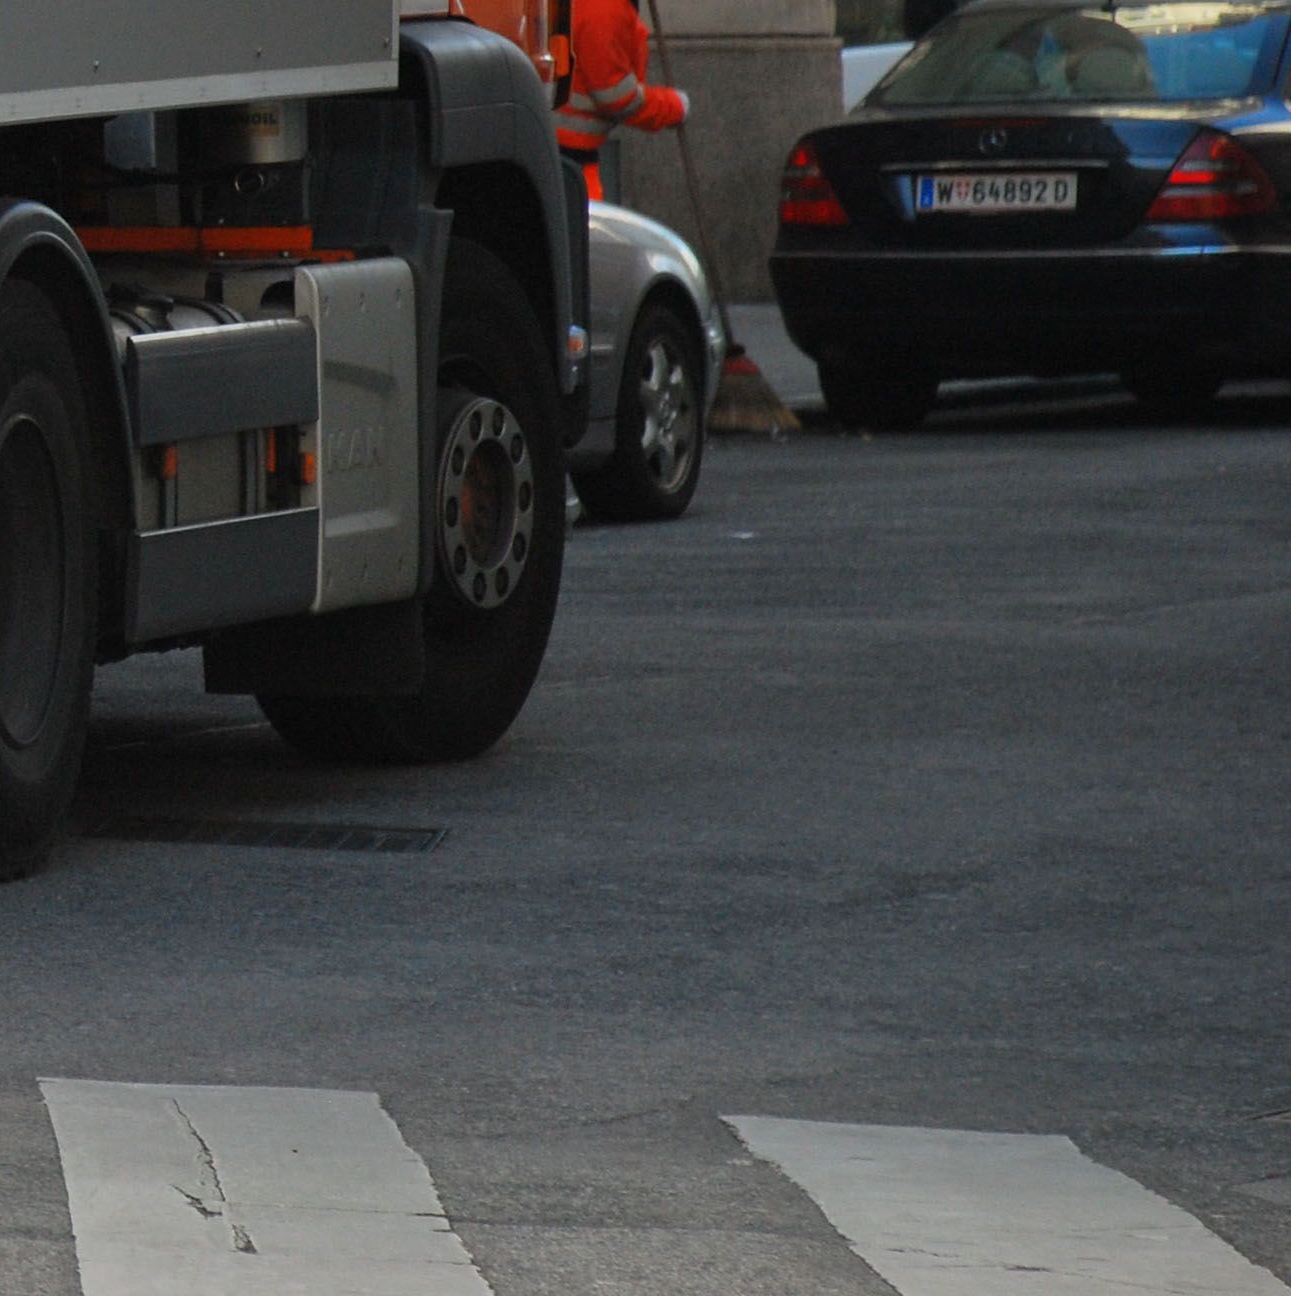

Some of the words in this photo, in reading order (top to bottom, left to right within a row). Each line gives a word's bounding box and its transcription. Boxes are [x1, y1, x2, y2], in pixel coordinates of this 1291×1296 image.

[936, 180, 954, 203] W
[972, 179, 1048, 204] 64892
[1054, 179, 1069, 203] D
